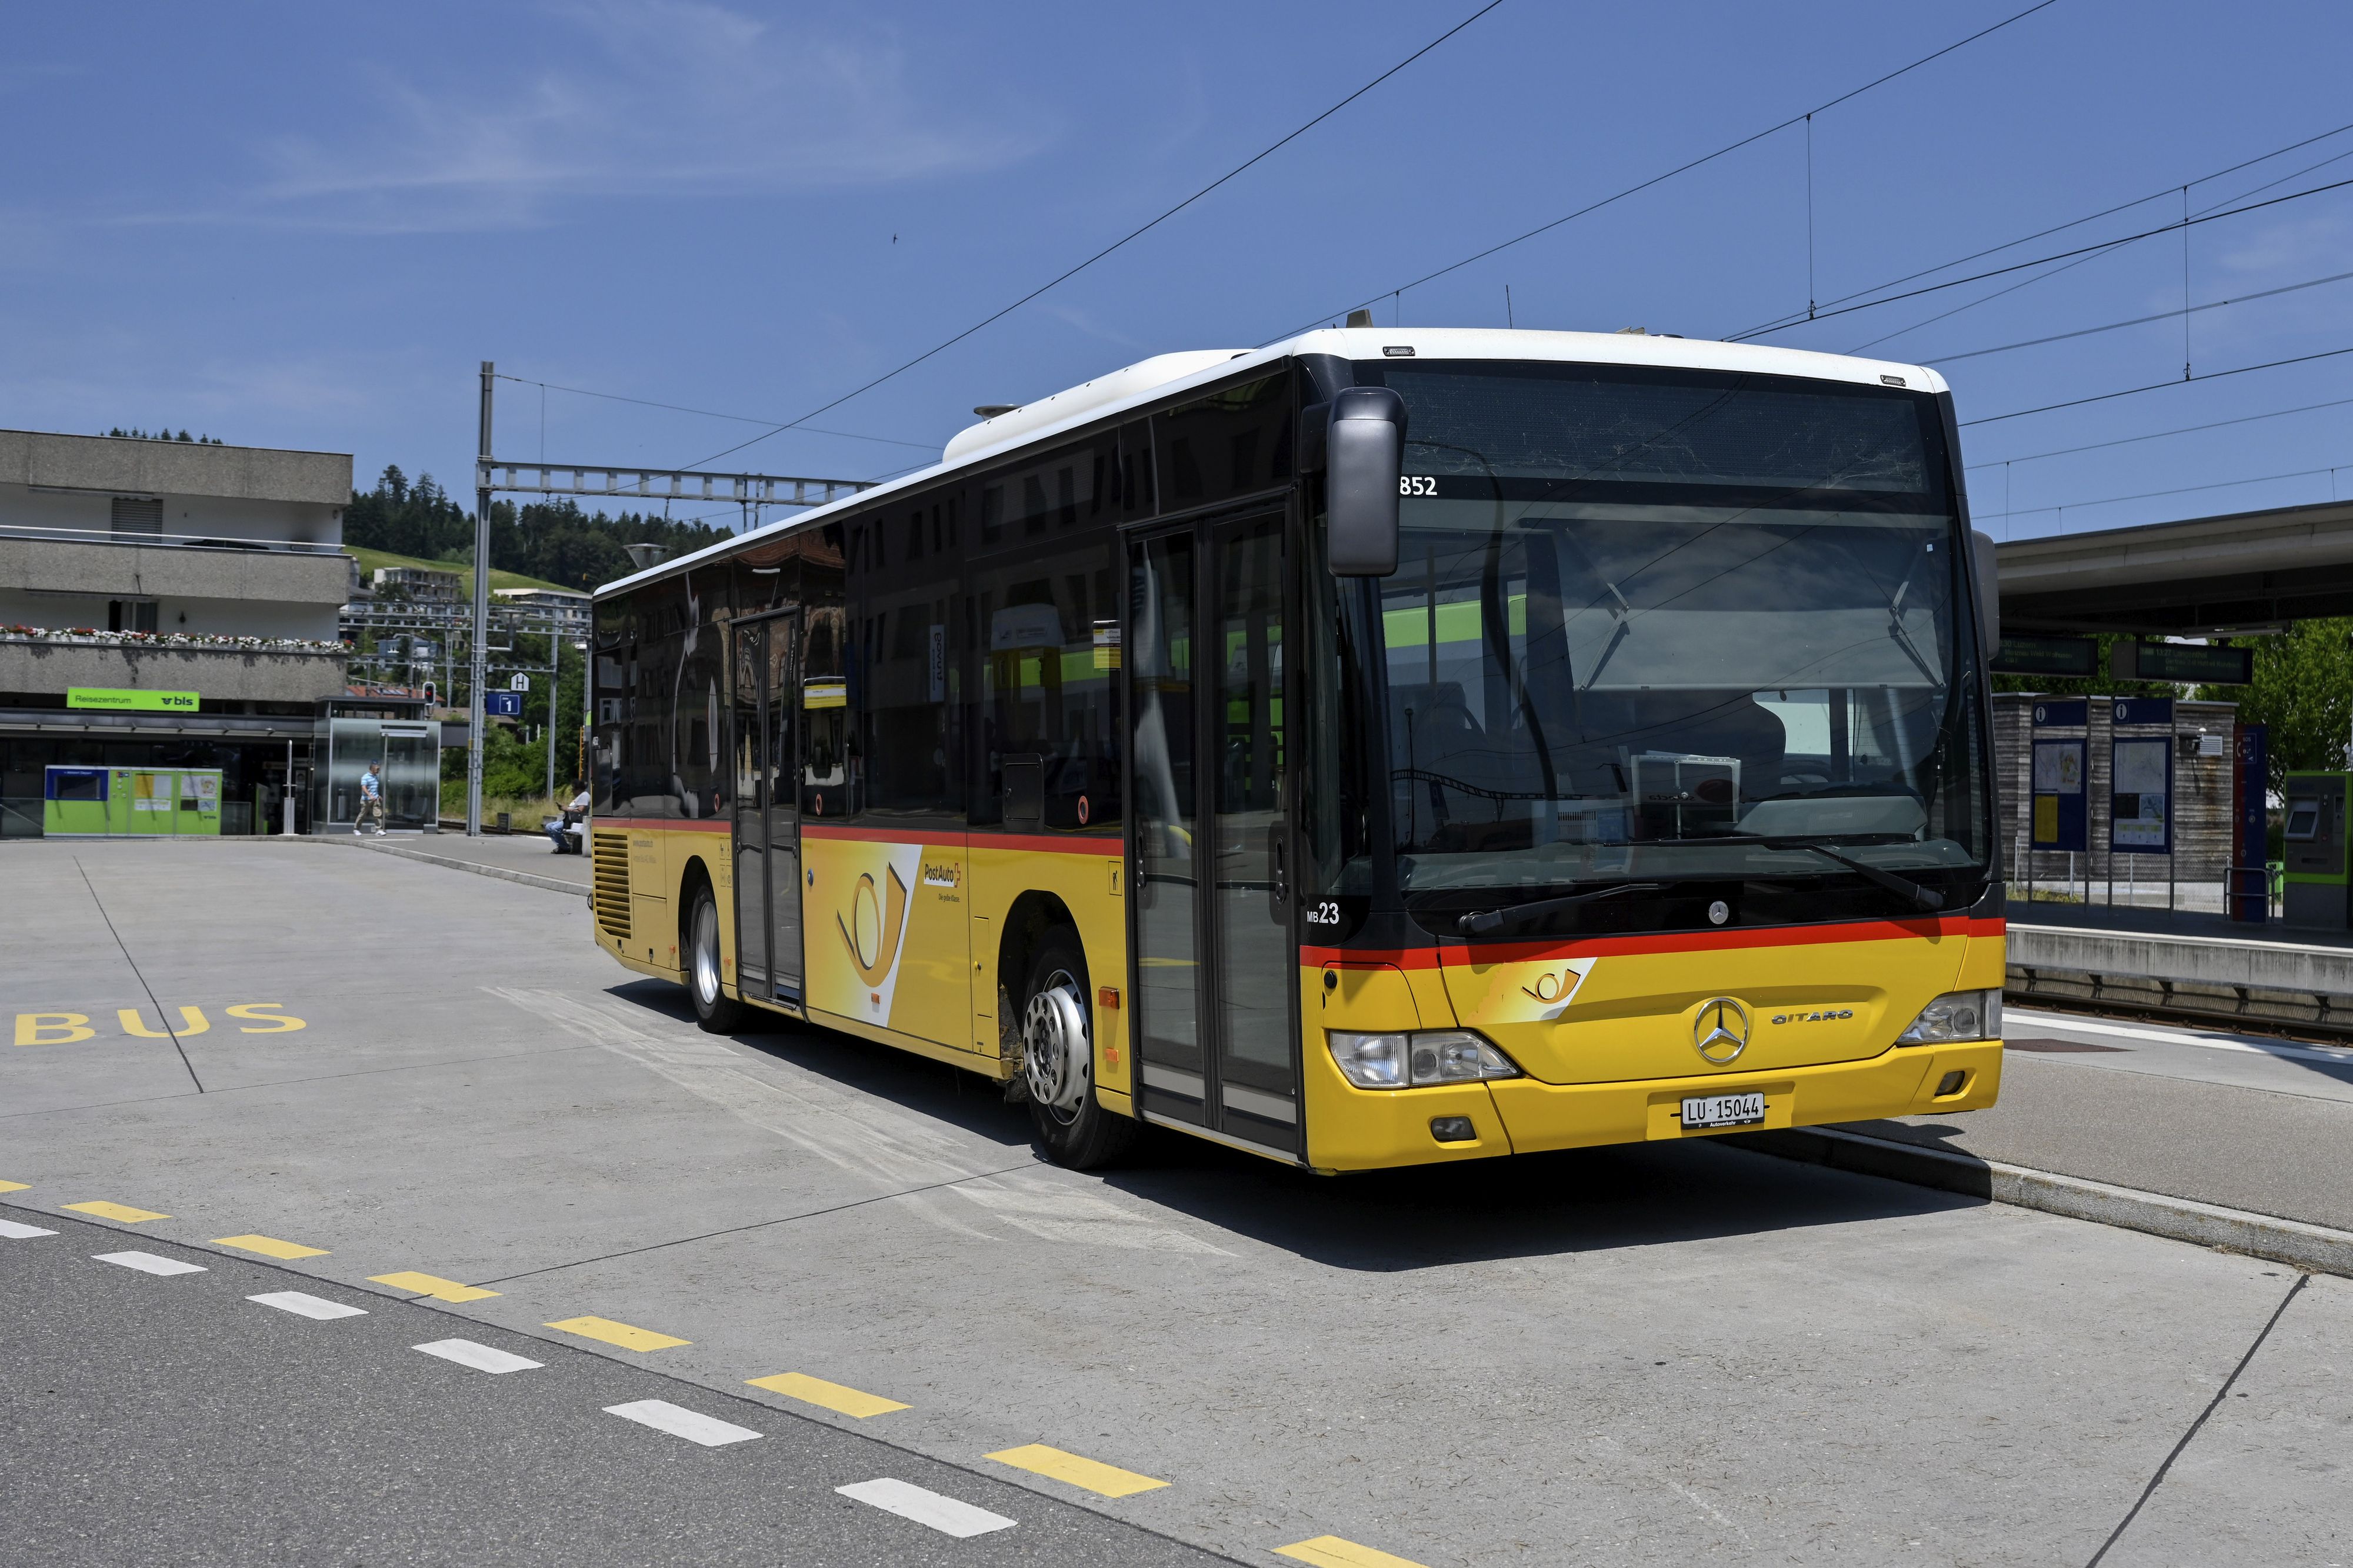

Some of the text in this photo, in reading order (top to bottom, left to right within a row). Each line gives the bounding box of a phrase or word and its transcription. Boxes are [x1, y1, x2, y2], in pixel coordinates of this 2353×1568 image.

[1400, 476, 1437, 495] 852
[516, 676, 524, 689] H
[75, 695, 193, 706] Reisezentrum bls
[506, 700, 512, 712] 1
[925, 863, 954, 882] PostAuto
[14, 1003, 306, 1046] BUS
